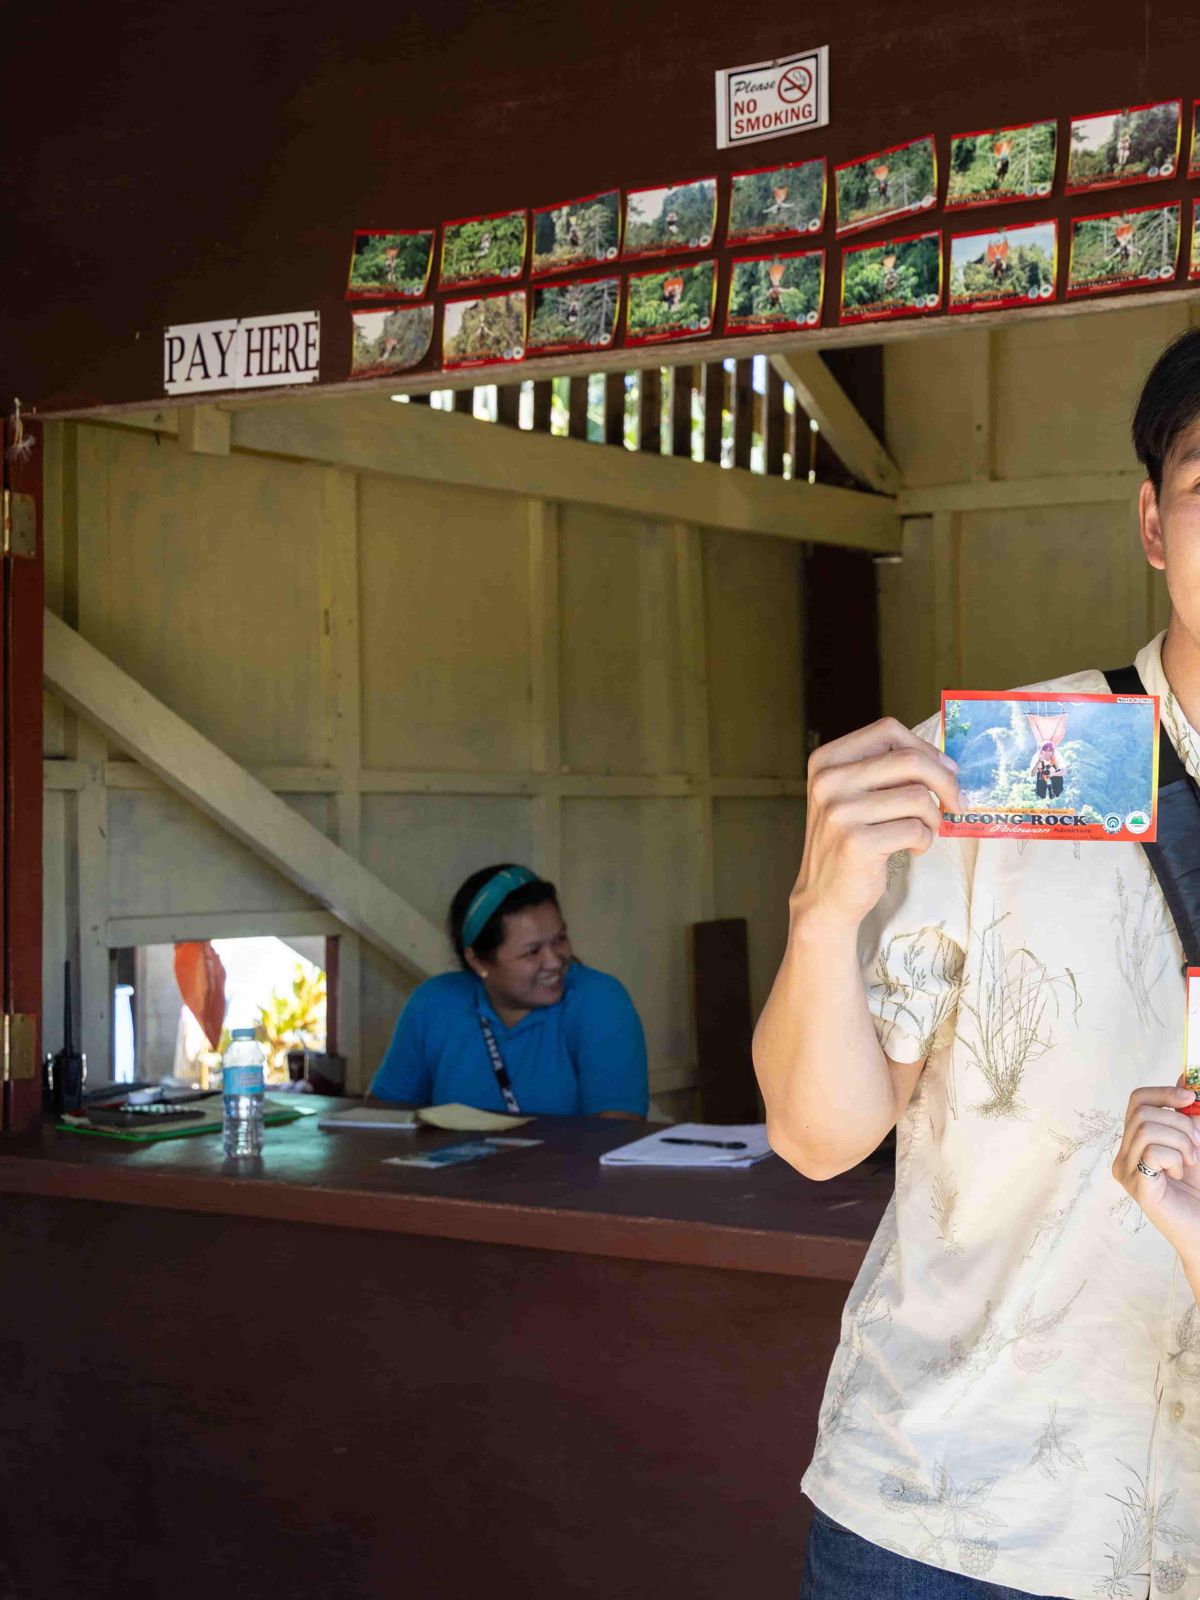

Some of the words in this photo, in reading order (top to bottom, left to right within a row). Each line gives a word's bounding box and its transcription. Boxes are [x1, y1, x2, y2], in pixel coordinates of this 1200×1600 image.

[734, 80, 776, 96] Please
[734, 99, 757, 117] NO
[735, 103, 813, 135] SMOKING
[166, 329, 237, 383] PAY
[244, 321, 318, 377] HERE
[950, 813, 1024, 825] UGONG
[1031, 814, 1088, 826] ROCK
[990, 823, 1050, 834] Palawan
